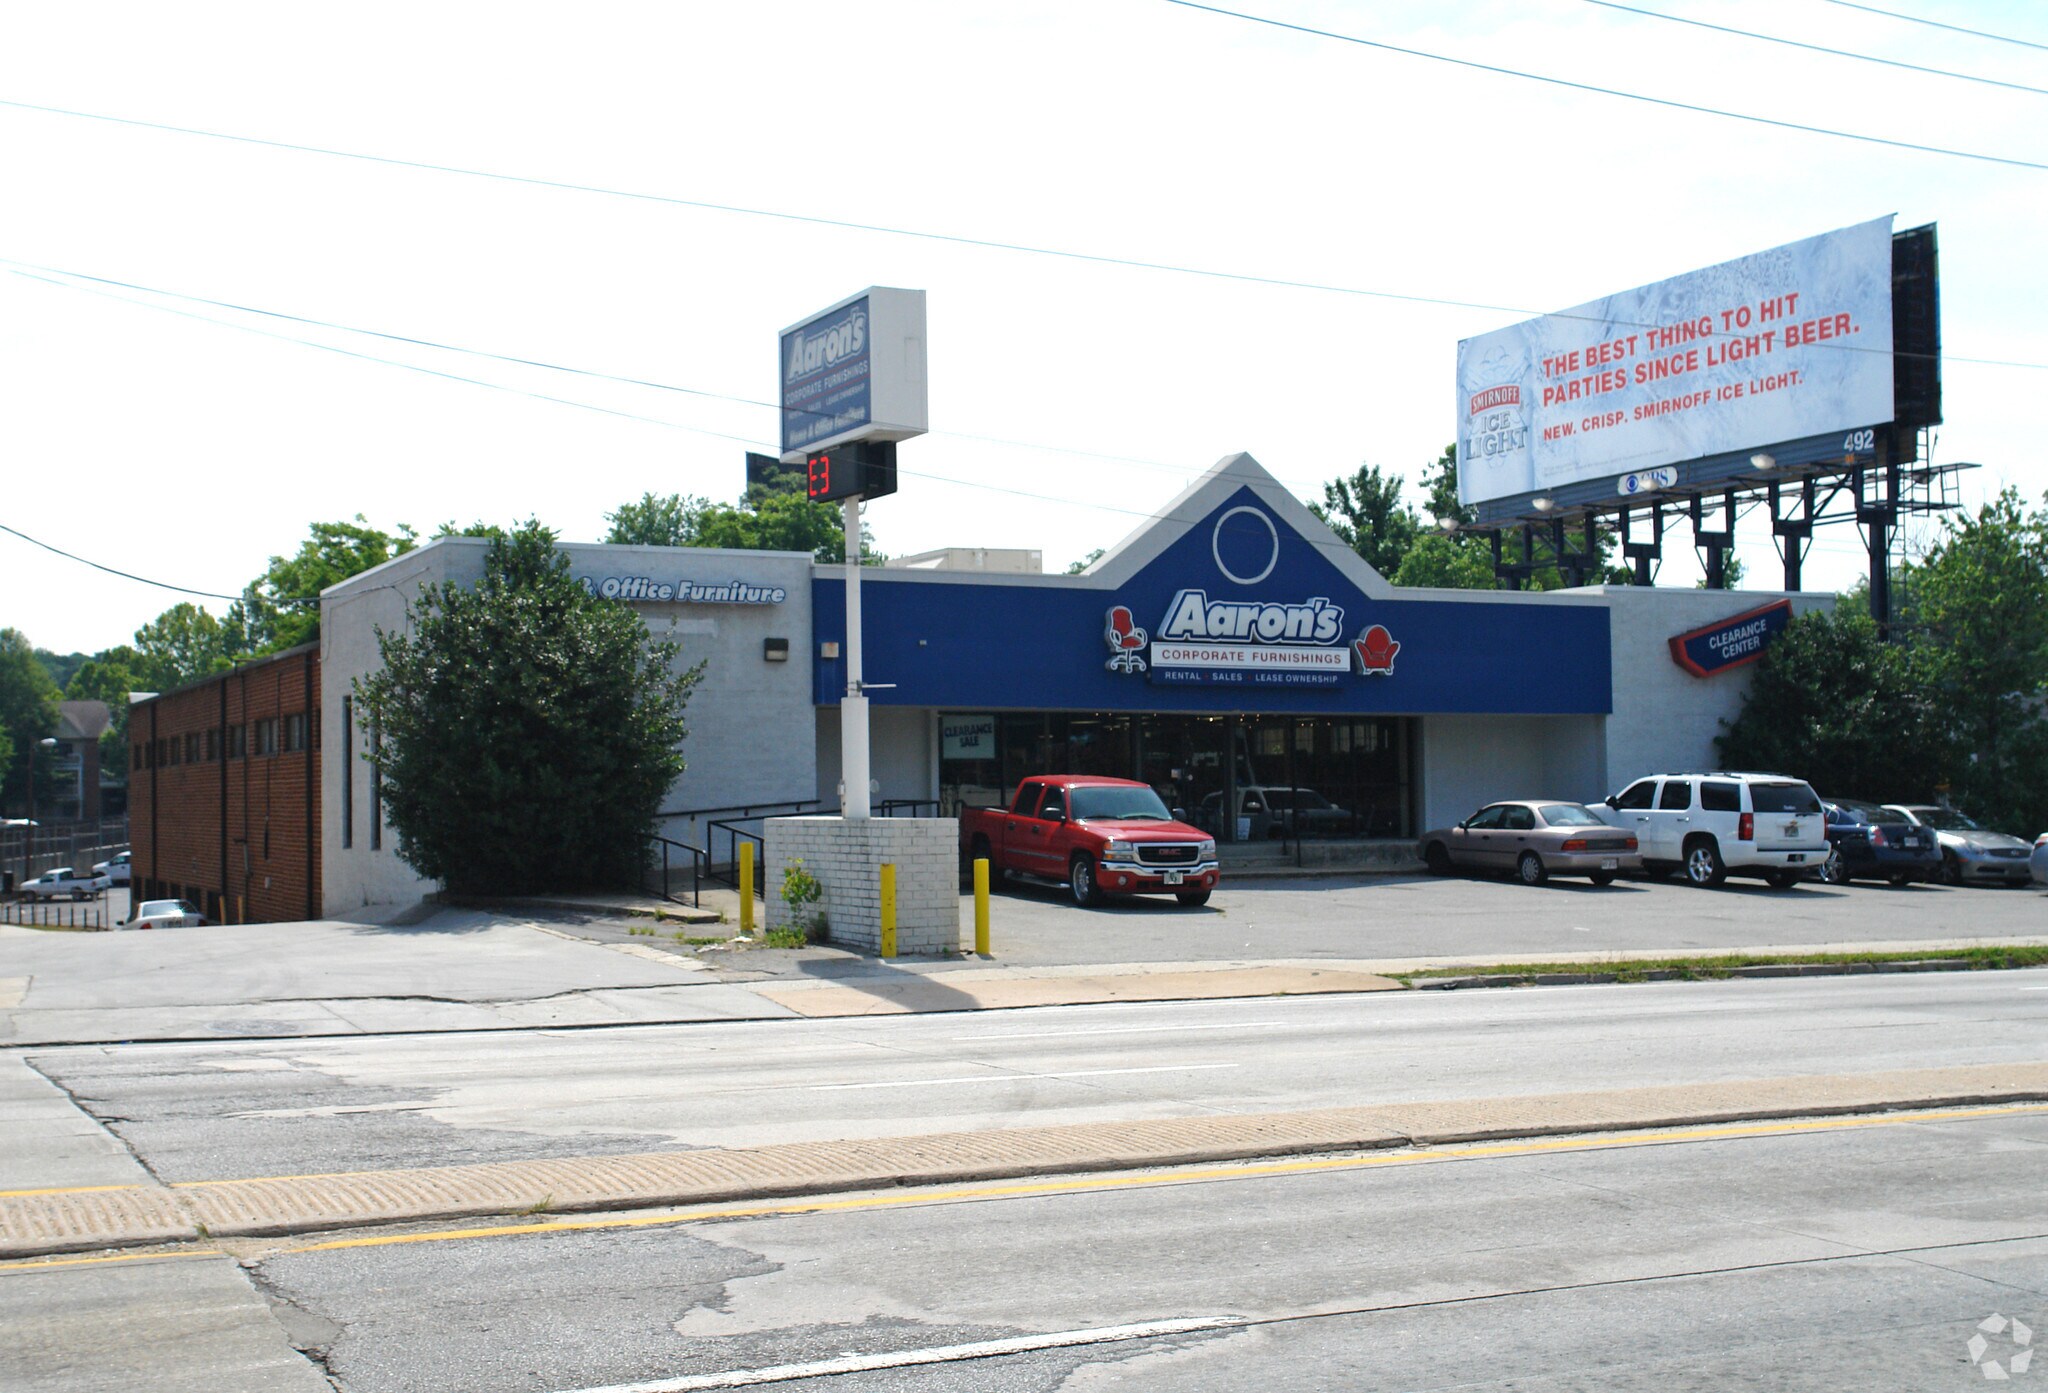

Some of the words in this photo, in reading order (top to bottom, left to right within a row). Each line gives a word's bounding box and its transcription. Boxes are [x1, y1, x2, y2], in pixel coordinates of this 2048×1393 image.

[787, 308, 866, 383] Aaron's
[1543, 351, 1580, 378] THE
[1586, 335, 1638, 367] BEST
[1646, 316, 1713, 350] THING
[1721, 306, 1751, 331] TO
[1760, 292, 1799, 322] HIT
[1543, 368, 1627, 407] PARTIES
[1635, 350, 1698, 384] SINCE
[1707, 331, 1776, 366] LIGHT
[1785, 313, 1860, 348] BEER.
[785, 380, 822, 405] CORPORATE
[824, 360, 868, 389] FURNISHINGS
[1472, 387, 1518, 413] SMIRNOFF
[1543, 421, 1577, 441] NEW.
[1582, 411, 1628, 432] CRISP.
[1634, 390, 1711, 421] SMIRNOFF
[1717, 382, 1744, 402] ICE
[1751, 370, 1803, 395] LIGHT.
[1481, 411, 1510, 434] ICE
[1466, 426, 1528, 460] LIGHT
[1844, 430, 1874, 452] 492
[601, 576, 673, 600] Office
[676, 579, 786, 604] Furniture
[1162, 590, 1343, 643] Aaron's
[1709, 619, 1767, 649] CLEARANCE
[1722, 635, 1760, 659] CENTER
[1162, 649, 1245, 662] CORPORATE
[1252, 652, 1342, 664] FURNISHINGS
[1165, 671, 1201, 680] RENTAL
[1212, 672, 1243, 681] SALES
[1255, 674, 1284, 682] LEASE
[1286, 674, 1338, 684] OWNERSHIP
[945, 723, 992, 737] CLEARANCE
[960, 736, 979, 747] SALE
